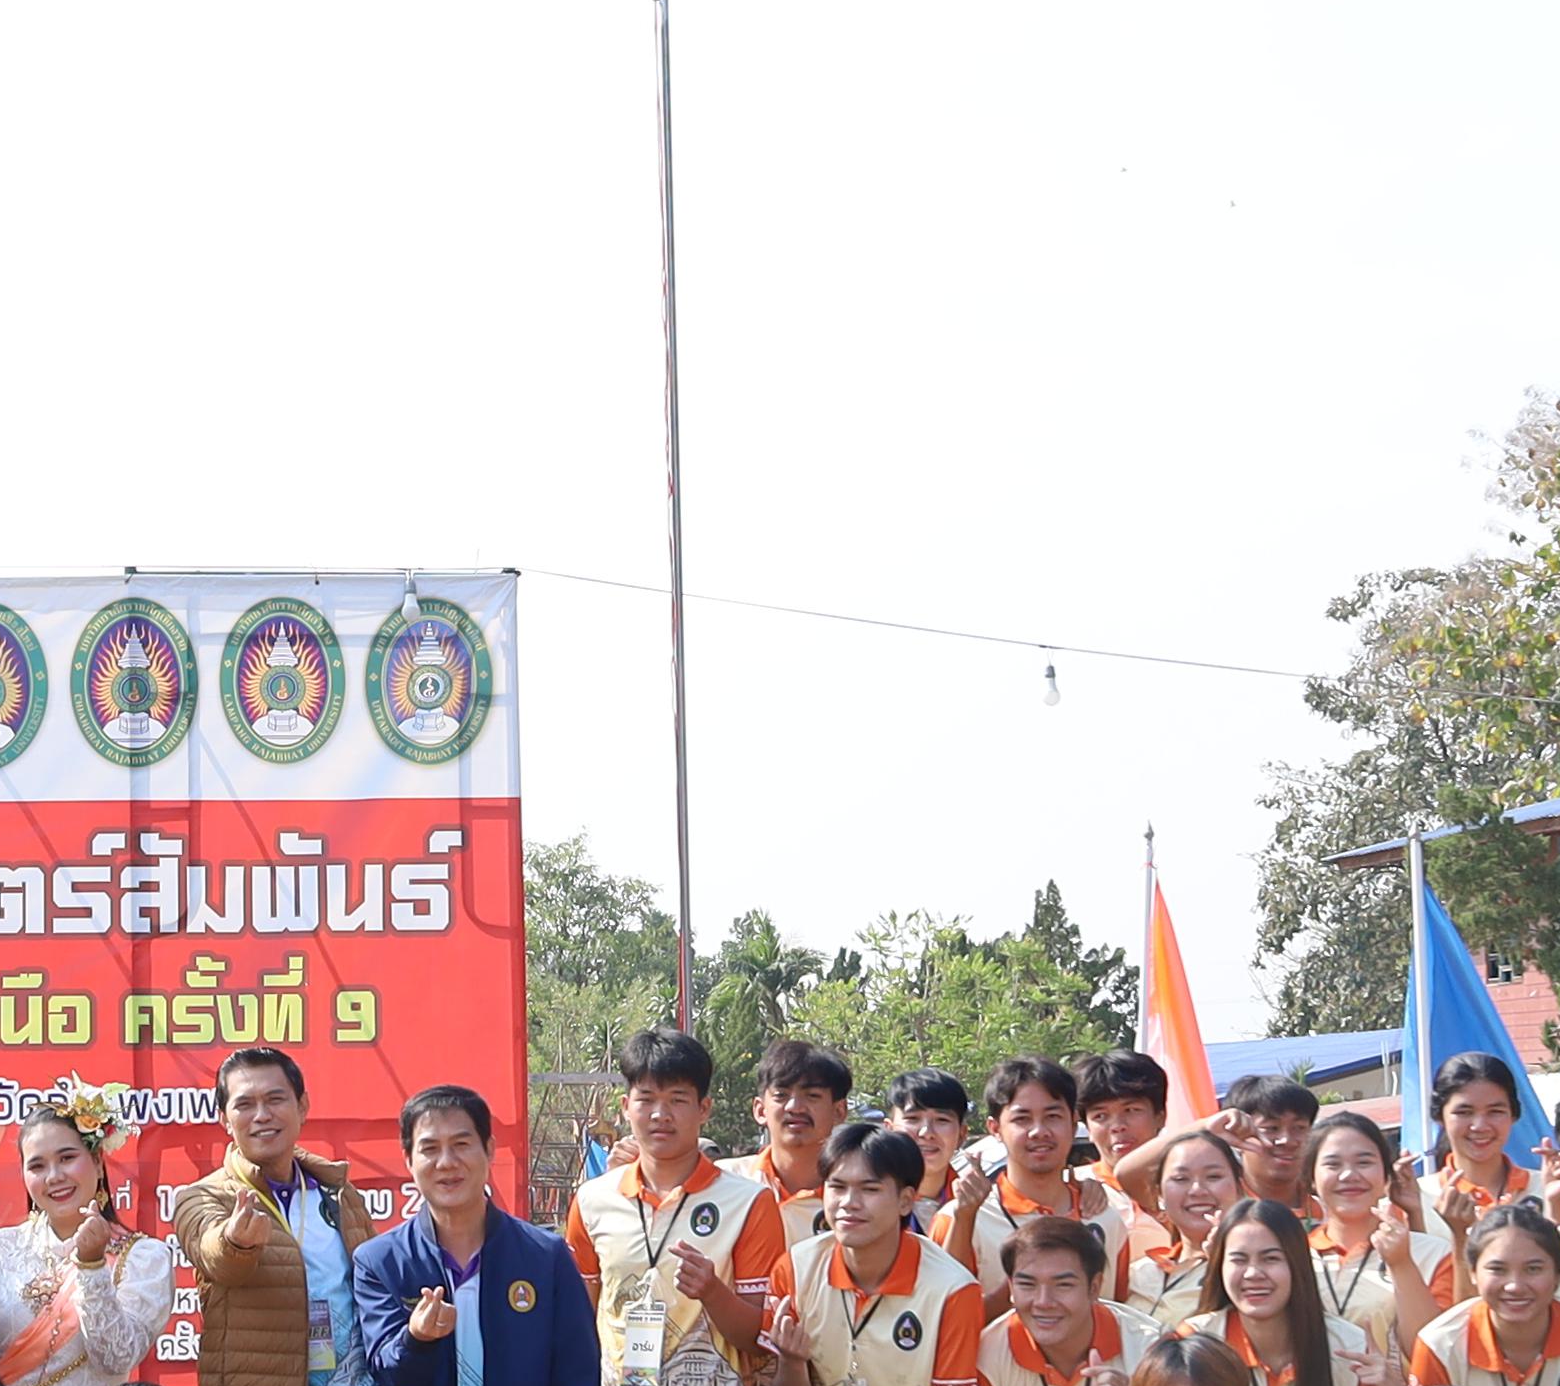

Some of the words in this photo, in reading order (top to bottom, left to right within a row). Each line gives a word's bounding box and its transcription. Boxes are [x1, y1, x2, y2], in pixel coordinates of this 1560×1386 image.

[11, 696, 45, 755] UNIVERSITY
[105, 749, 160, 766] RAJABHAT
[161, 693, 195, 754] UNIVERSITY
[223, 693, 252, 745] LAMPANG
[251, 743, 305, 762] RAJABHAT
[306, 694, 342, 751] UNIVERSITY
[371, 700, 405, 751] UTTARADIT
[405, 744, 453, 762] RAJABHAT
[453, 698, 488, 752] UNIVERSITY
[124, 955, 307, 1047] ครั้งที่
